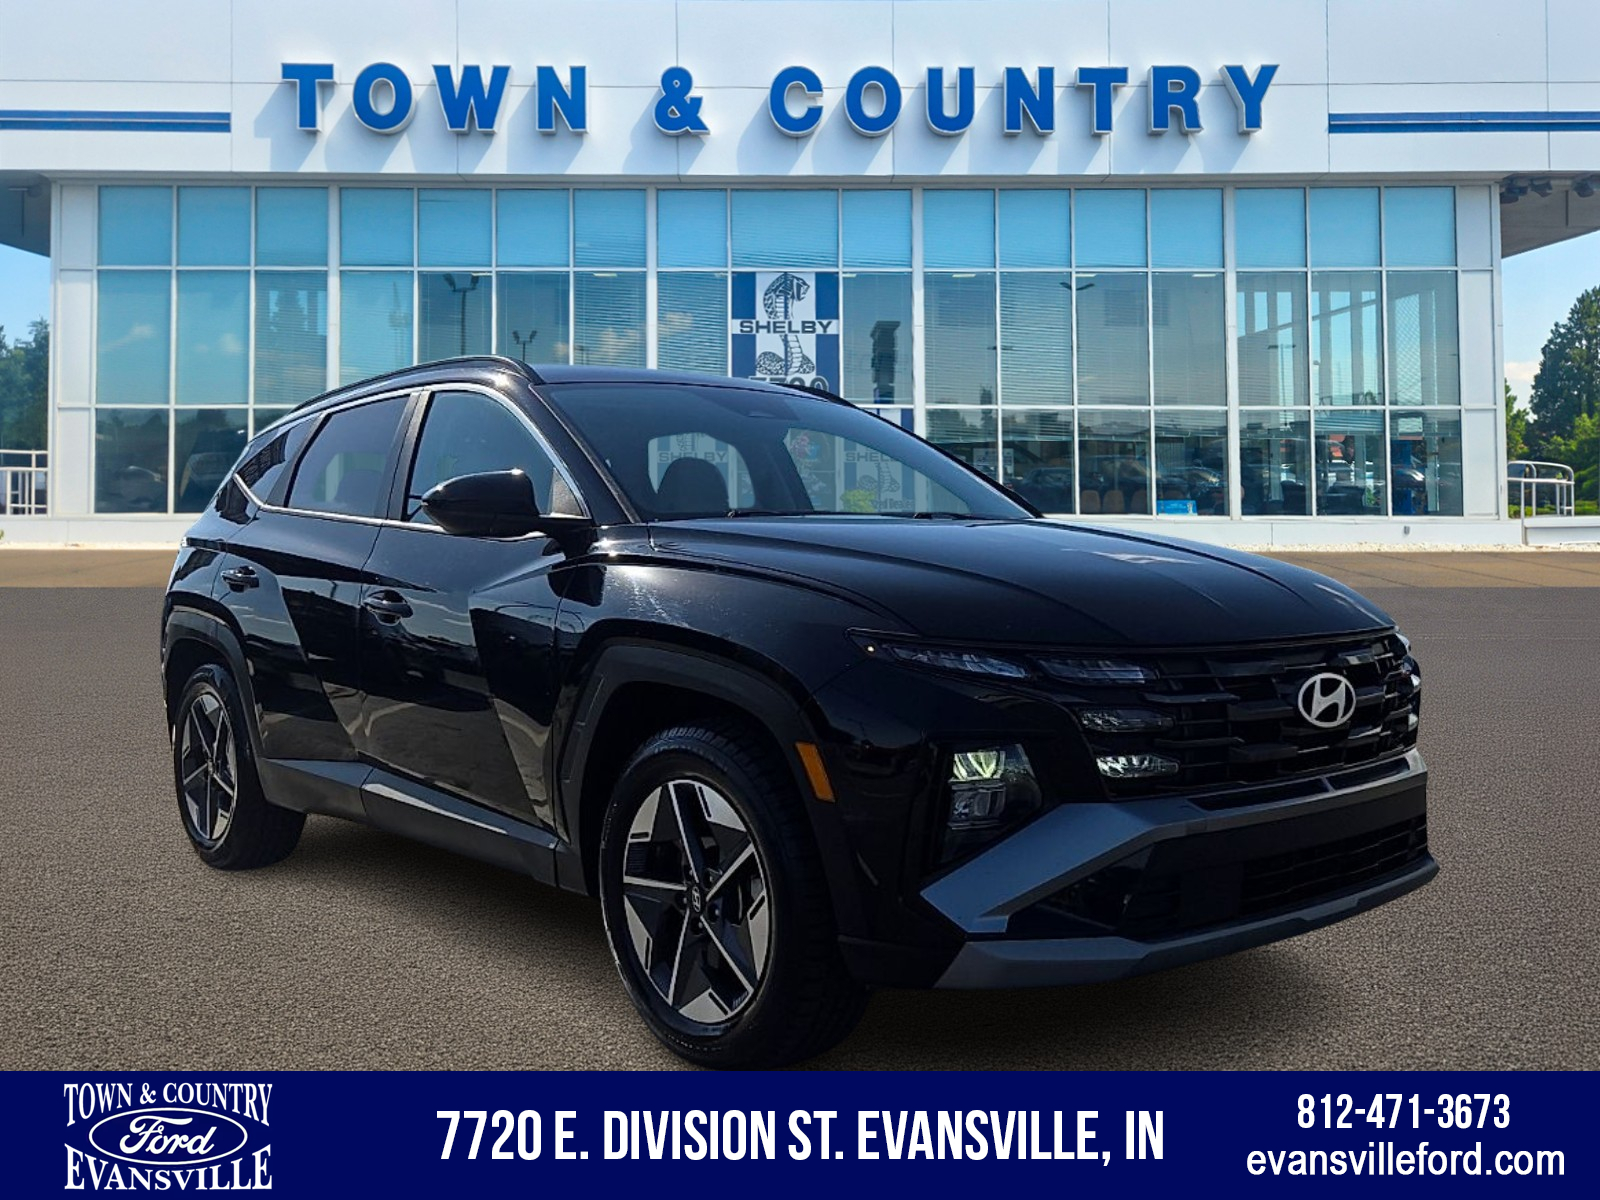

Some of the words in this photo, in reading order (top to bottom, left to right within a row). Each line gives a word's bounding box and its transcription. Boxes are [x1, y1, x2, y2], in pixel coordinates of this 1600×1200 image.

[281, 62, 588, 133] TOWN
[653, 66, 710, 135] &
[768, 63, 1279, 136] COUNTRY
[739, 320, 833, 334] SHELBY
